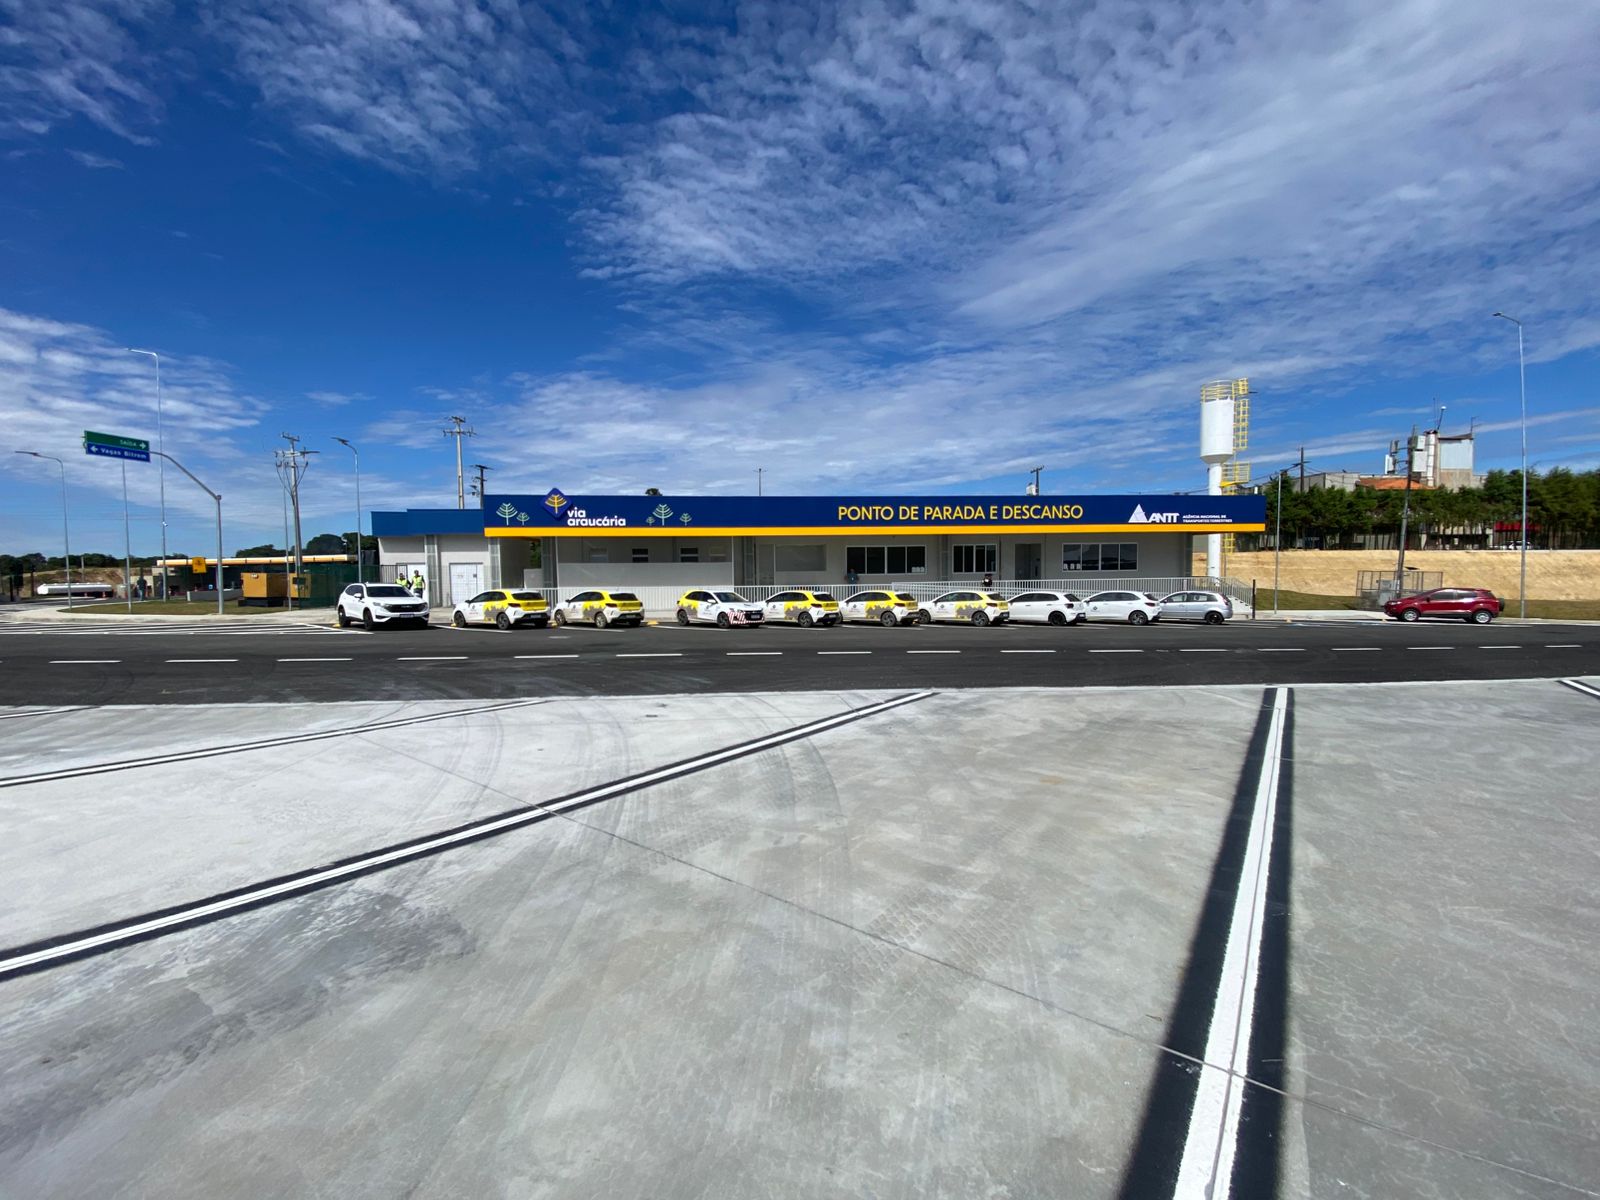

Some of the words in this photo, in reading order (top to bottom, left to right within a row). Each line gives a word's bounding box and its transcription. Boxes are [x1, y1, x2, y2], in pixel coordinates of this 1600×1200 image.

[567, 506, 586, 517] via
[838, 506, 894, 521] PONTO
[899, 506, 919, 520] DE
[924, 505, 986, 520] PARADA
[990, 505, 998, 519] E
[1002, 505, 1084, 519] DESCANSO
[567, 515, 626, 526] araucária
[1149, 512, 1180, 523] ANTT
